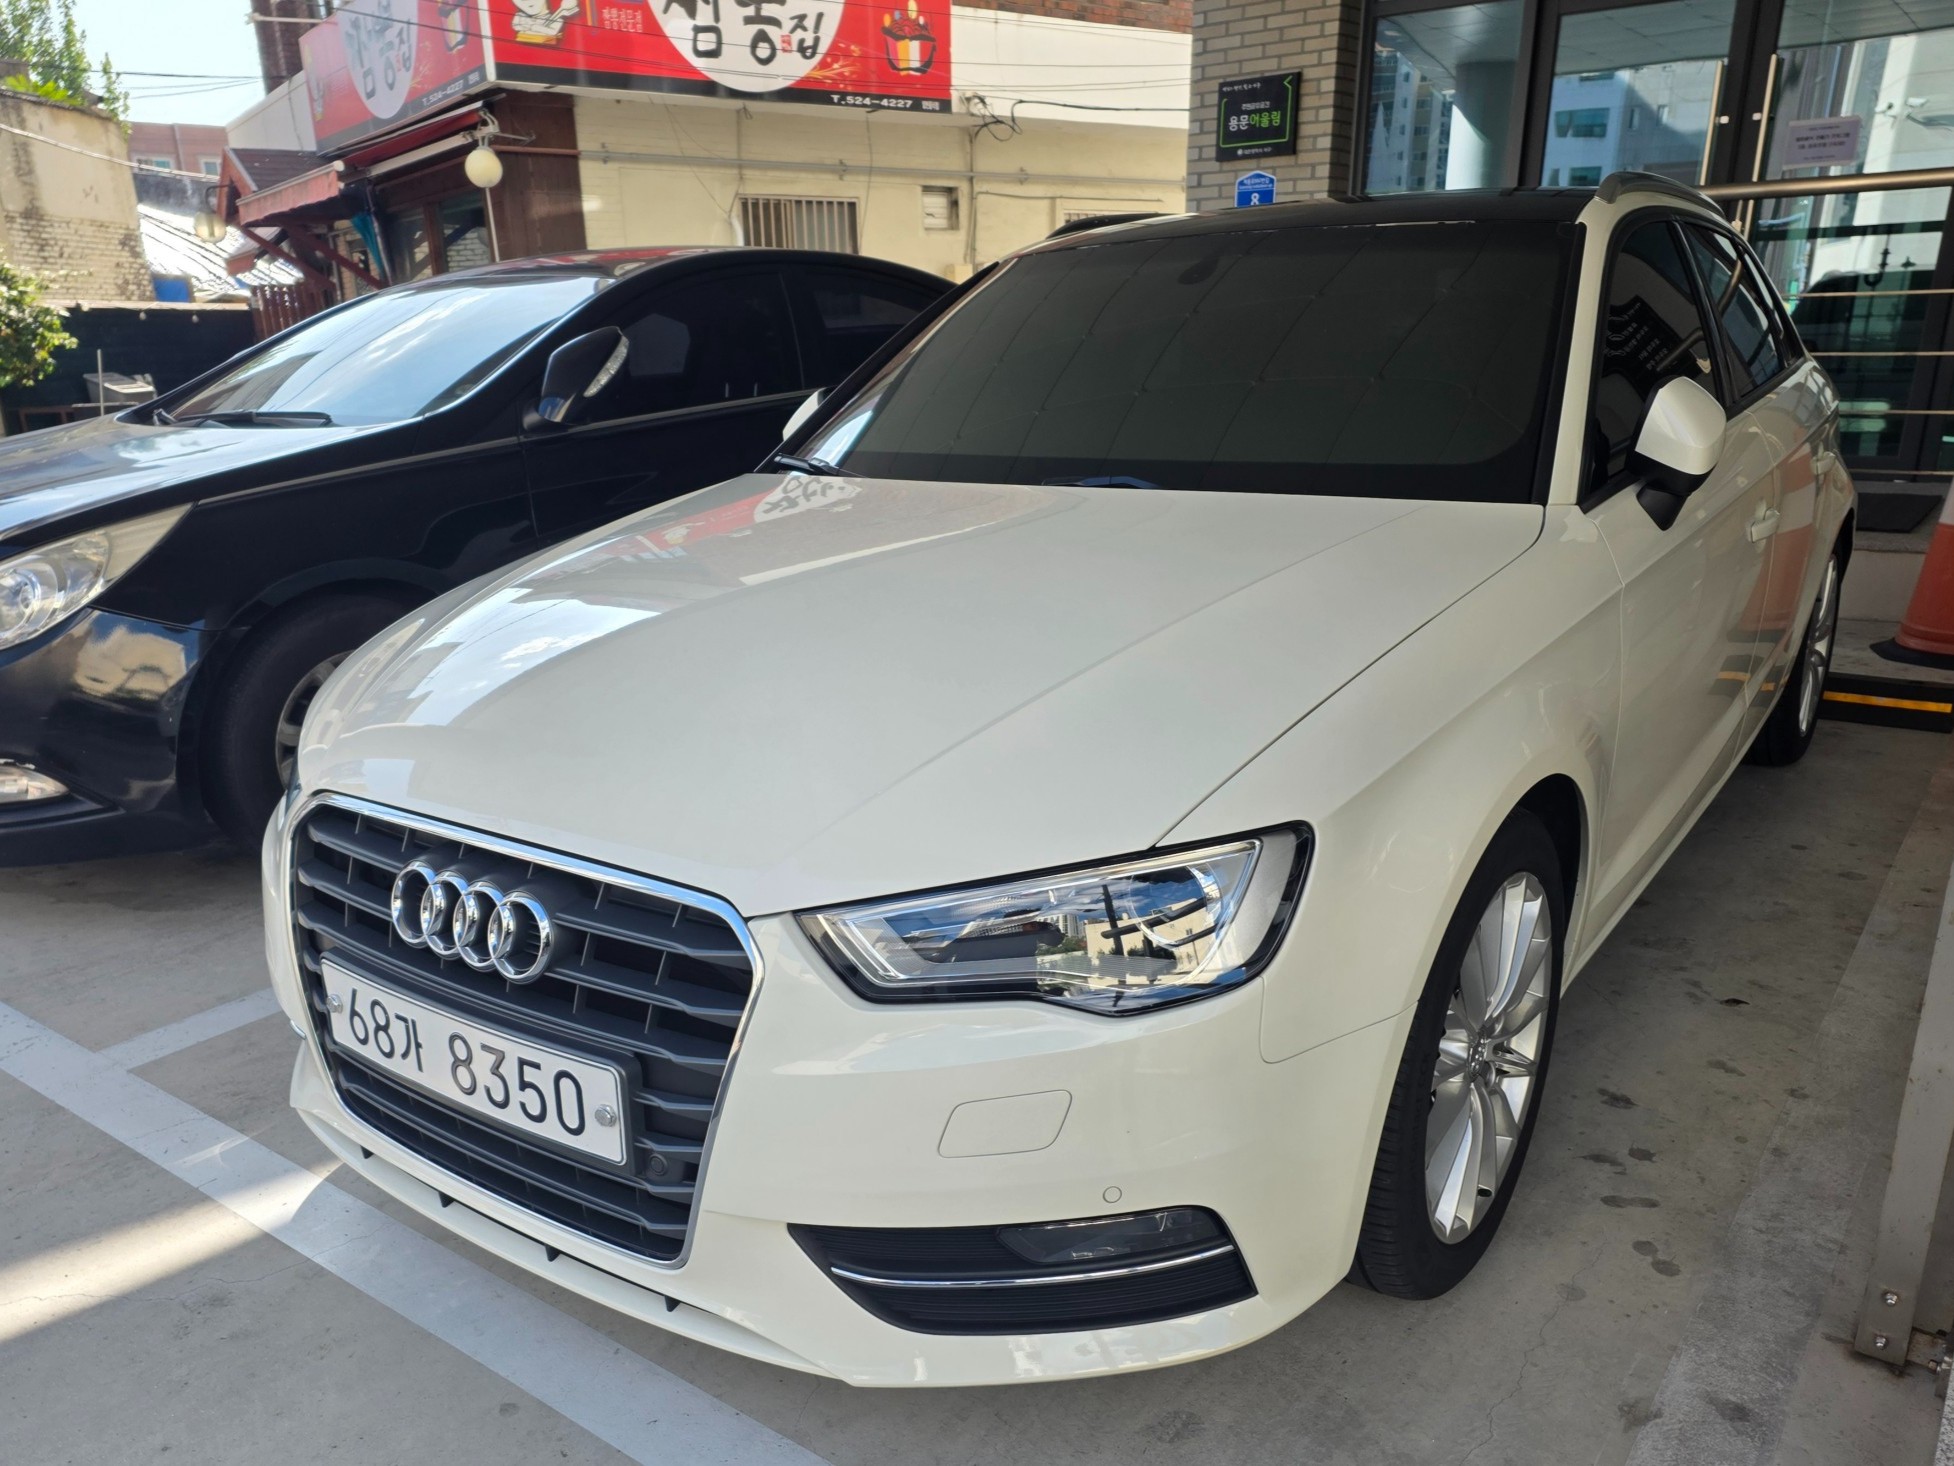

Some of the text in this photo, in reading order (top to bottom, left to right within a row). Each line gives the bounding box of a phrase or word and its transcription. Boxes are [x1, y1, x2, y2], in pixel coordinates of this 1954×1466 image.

[830, 94, 914, 108] T.524-4227
[1228, 110, 1281, 132] 용문어울림
[348, 987, 586, 1137] 68가 8350
